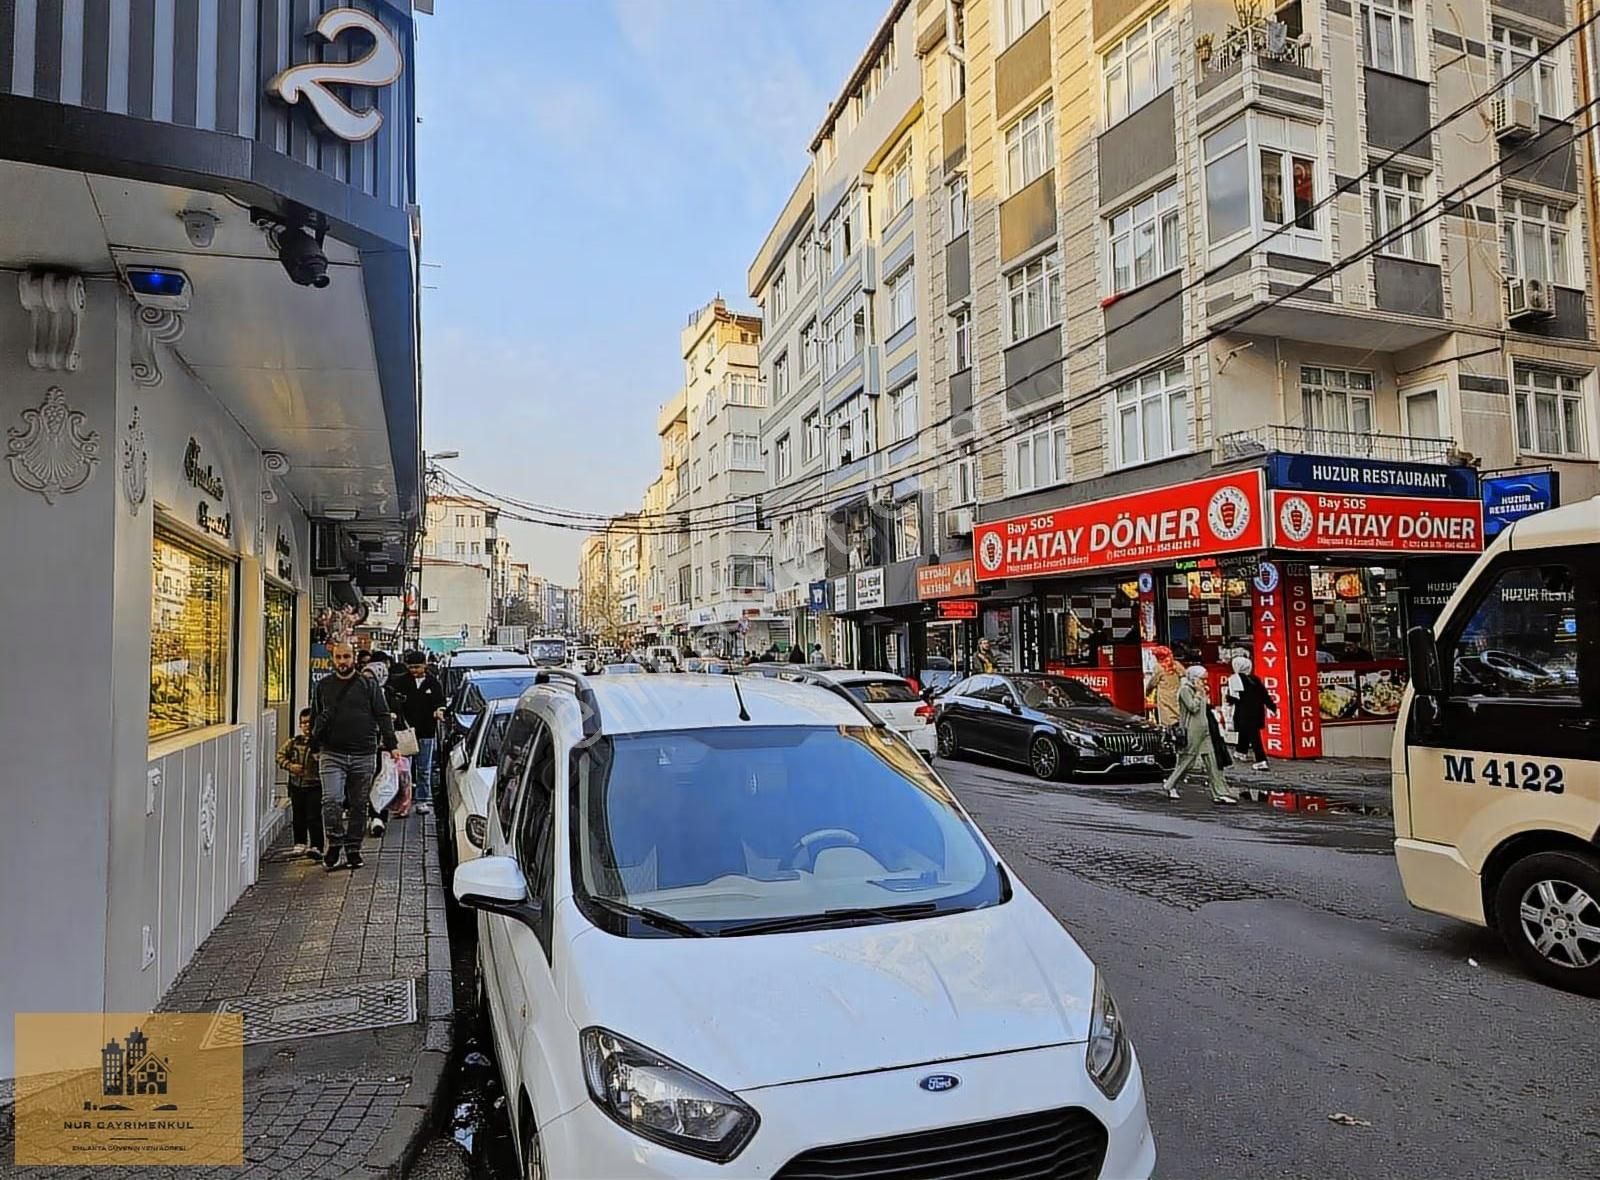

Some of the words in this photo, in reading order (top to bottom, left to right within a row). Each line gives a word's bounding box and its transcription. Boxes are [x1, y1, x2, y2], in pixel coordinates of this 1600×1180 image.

[1312, 464, 1359, 483] HUZUR
[1363, 468, 1448, 488] RESTAURANT
[1318, 496, 1341, 511] Bay
[1343, 497, 1367, 510] SOS
[1489, 502, 1545, 515] RESTAURANT
[1501, 494, 1531, 505] HUZUR
[1006, 527, 1084, 563] HATAY
[1090, 508, 1201, 550] DÖNER
[1007, 522, 1028, 536] Bay
[1030, 516, 1055, 531] SOS
[1317, 512, 1394, 537] HATAY
[1398, 511, 1475, 540] DÖNER
[953, 567, 971, 587] 44
[1413, 596, 1453, 605] RESTAU
[1259, 595, 1278, 668] HATAY
[1293, 586, 1308, 656] SOSLU
[1298, 675, 1316, 748] DÜRÜM
[1443, 755, 1475, 784] M
[1482, 759, 1564, 794] 4122
